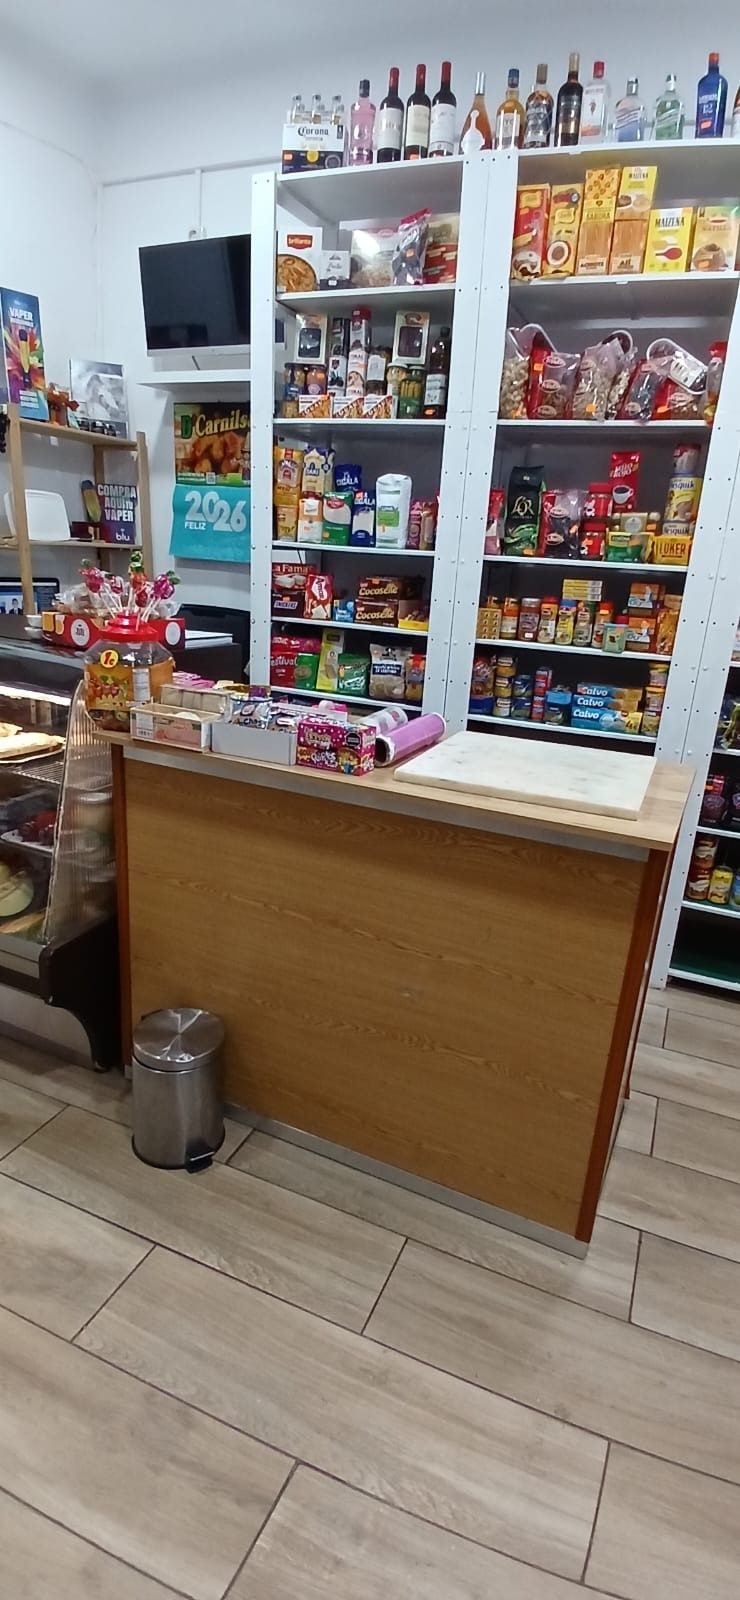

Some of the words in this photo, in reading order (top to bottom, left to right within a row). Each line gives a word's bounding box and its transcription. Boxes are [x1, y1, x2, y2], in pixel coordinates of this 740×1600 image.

[297, 126, 329, 136] Corona
[655, 216, 685, 228] MAIZENA
[97, 484, 137, 498] COMPRA
[185, 490, 247, 532] 2026
[184, 521, 207, 531] FELIZ
[115, 530, 130, 541] blu
[660, 545, 687, 555] LUKER
[282, 563, 308, 574] Fama
[582, 686, 608, 697] Calvo
[577, 697, 604, 708] Calvo
[573, 709, 600, 720] Calvo
